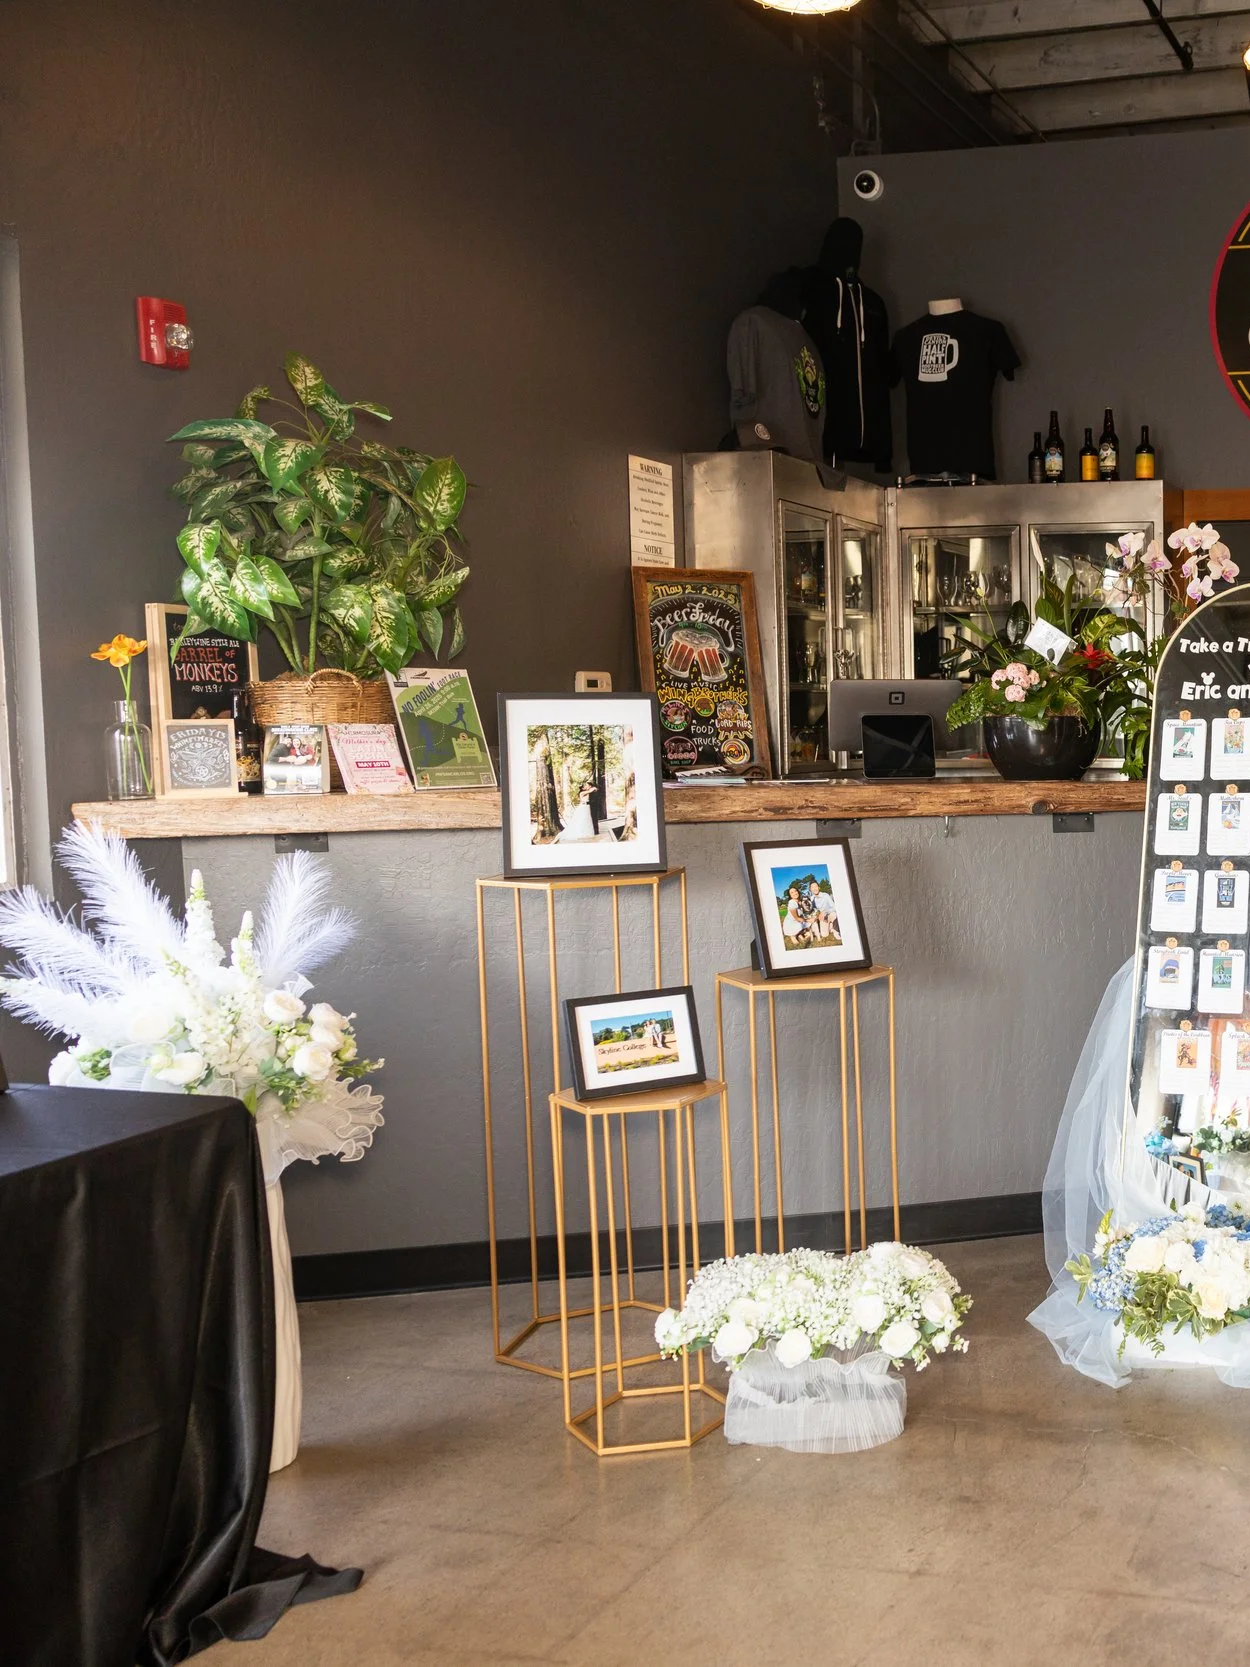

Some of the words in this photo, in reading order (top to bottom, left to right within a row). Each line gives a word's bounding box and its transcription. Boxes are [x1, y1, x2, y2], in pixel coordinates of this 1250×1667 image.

[149, 319, 157, 349] FIRE
[923, 344, 946, 355] HALF
[922, 353, 945, 365] PINT
[640, 463, 662, 476] WARNING
[644, 544, 663, 555] NOTICE
[655, 584, 683, 597] May
[702, 586, 736, 604] 2025
[651, 608, 690, 647] Beer
[687, 602, 735, 652] Friday
[211, 639, 228, 647] STYLE
[229, 640, 239, 648] ALE
[1179, 637, 1219, 654] Take
[1222, 641, 1233, 653] a
[174, 663, 239, 683] MONKEYS
[671, 680, 688, 688] LIVE
[691, 681, 717, 691] MUSIC
[1181, 673, 1221, 701] Eric
[402, 701, 414, 714] NO
[413, 681, 436, 706] FOOLIN'
[437, 676, 447, 688] FOOT
[448, 671, 461, 682] RACE
[691, 725, 714, 735] FOOD
[692, 737, 721, 747] TRUCKS
[598, 1046, 621, 1056] Skyline
[622, 1042, 647, 1050] College
